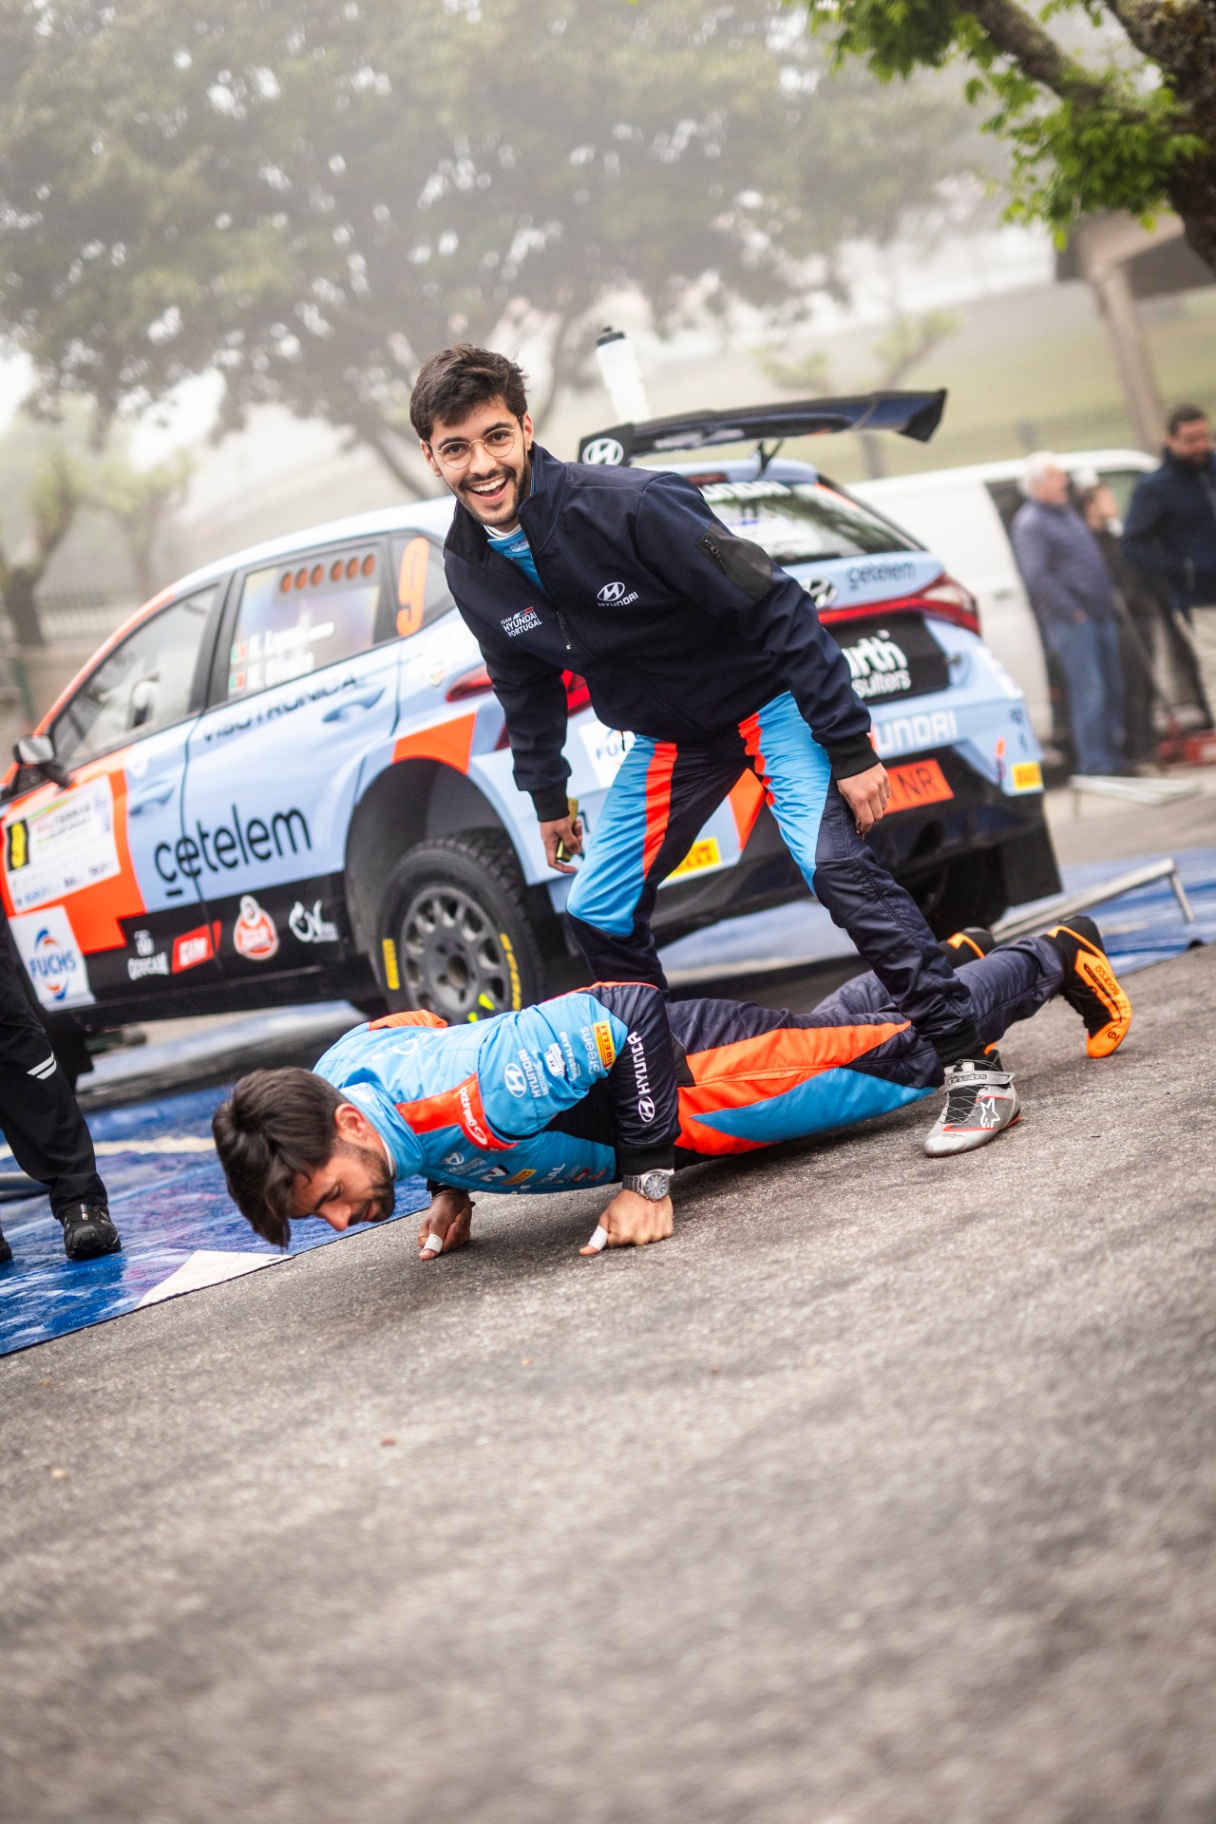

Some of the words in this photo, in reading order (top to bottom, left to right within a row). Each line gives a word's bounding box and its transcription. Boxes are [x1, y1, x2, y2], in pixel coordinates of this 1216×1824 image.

[703, 481, 793, 499] UNDAI
[396, 536, 430, 637] 9
[847, 561, 917, 591] cetelem
[597, 591, 639, 607] HYUNDAI
[502, 611, 538, 632] HYUNDAI
[507, 618, 543, 638] PORTUGAL
[841, 637, 908, 679] rth
[852, 669, 912, 699] sulters
[872, 710, 958, 750] UNDAI
[153, 804, 312, 897] cetelem
[29, 950, 77, 979] FUCHS
[1095, 965, 1121, 996] sparco
[579, 1026, 600, 1075] Greens
[518, 1049, 542, 1098] HYUNDAI
